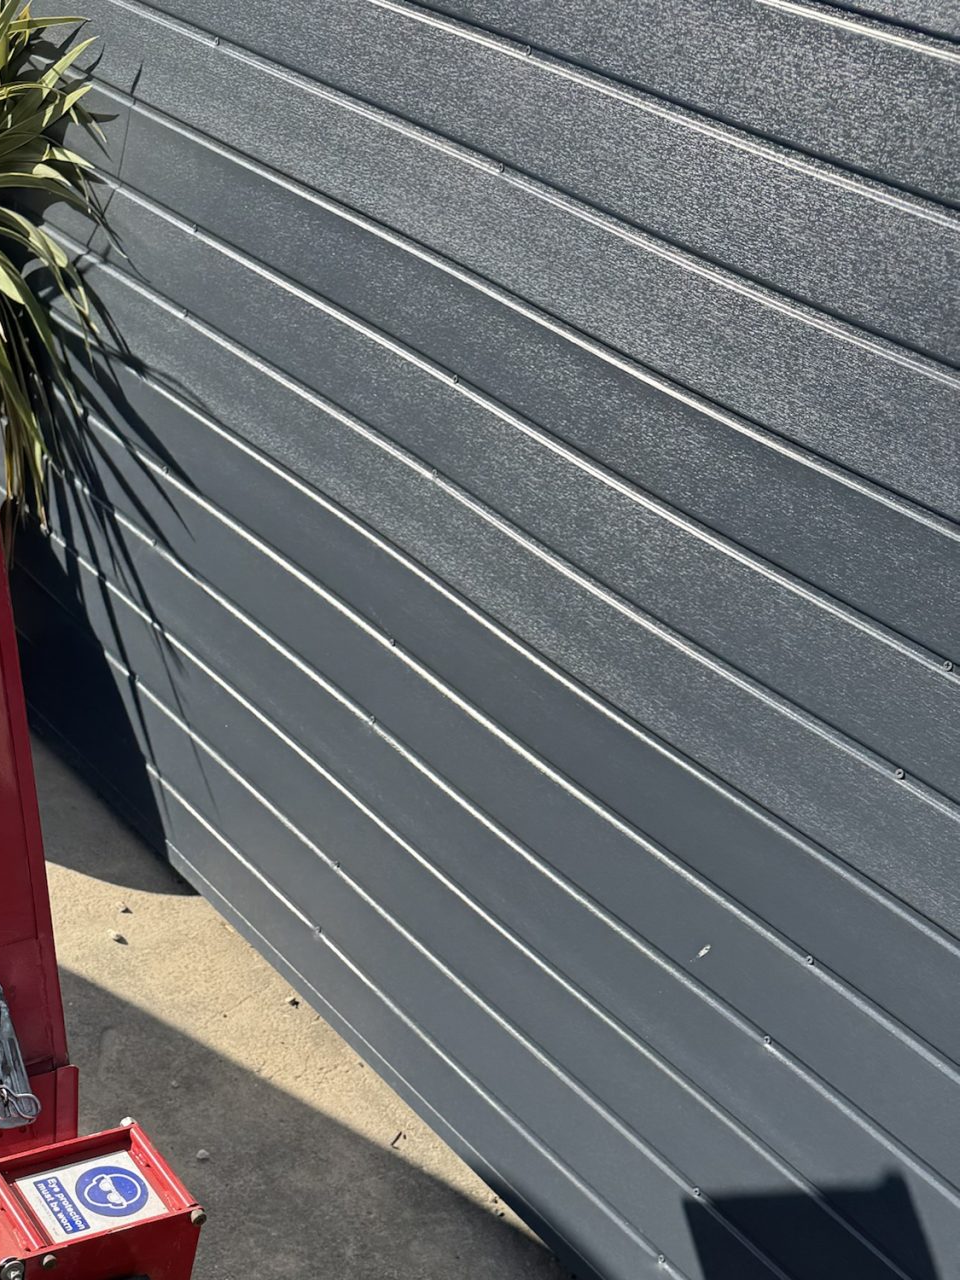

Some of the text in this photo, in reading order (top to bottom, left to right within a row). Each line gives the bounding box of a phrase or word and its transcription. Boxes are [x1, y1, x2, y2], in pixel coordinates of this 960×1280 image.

[36, 1183, 55, 1202] must
[50, 1201, 60, 1212] be
[57, 1212, 73, 1231] worn
[47, 1178, 60, 1193] Eye
[54, 1193, 86, 1230] protection
